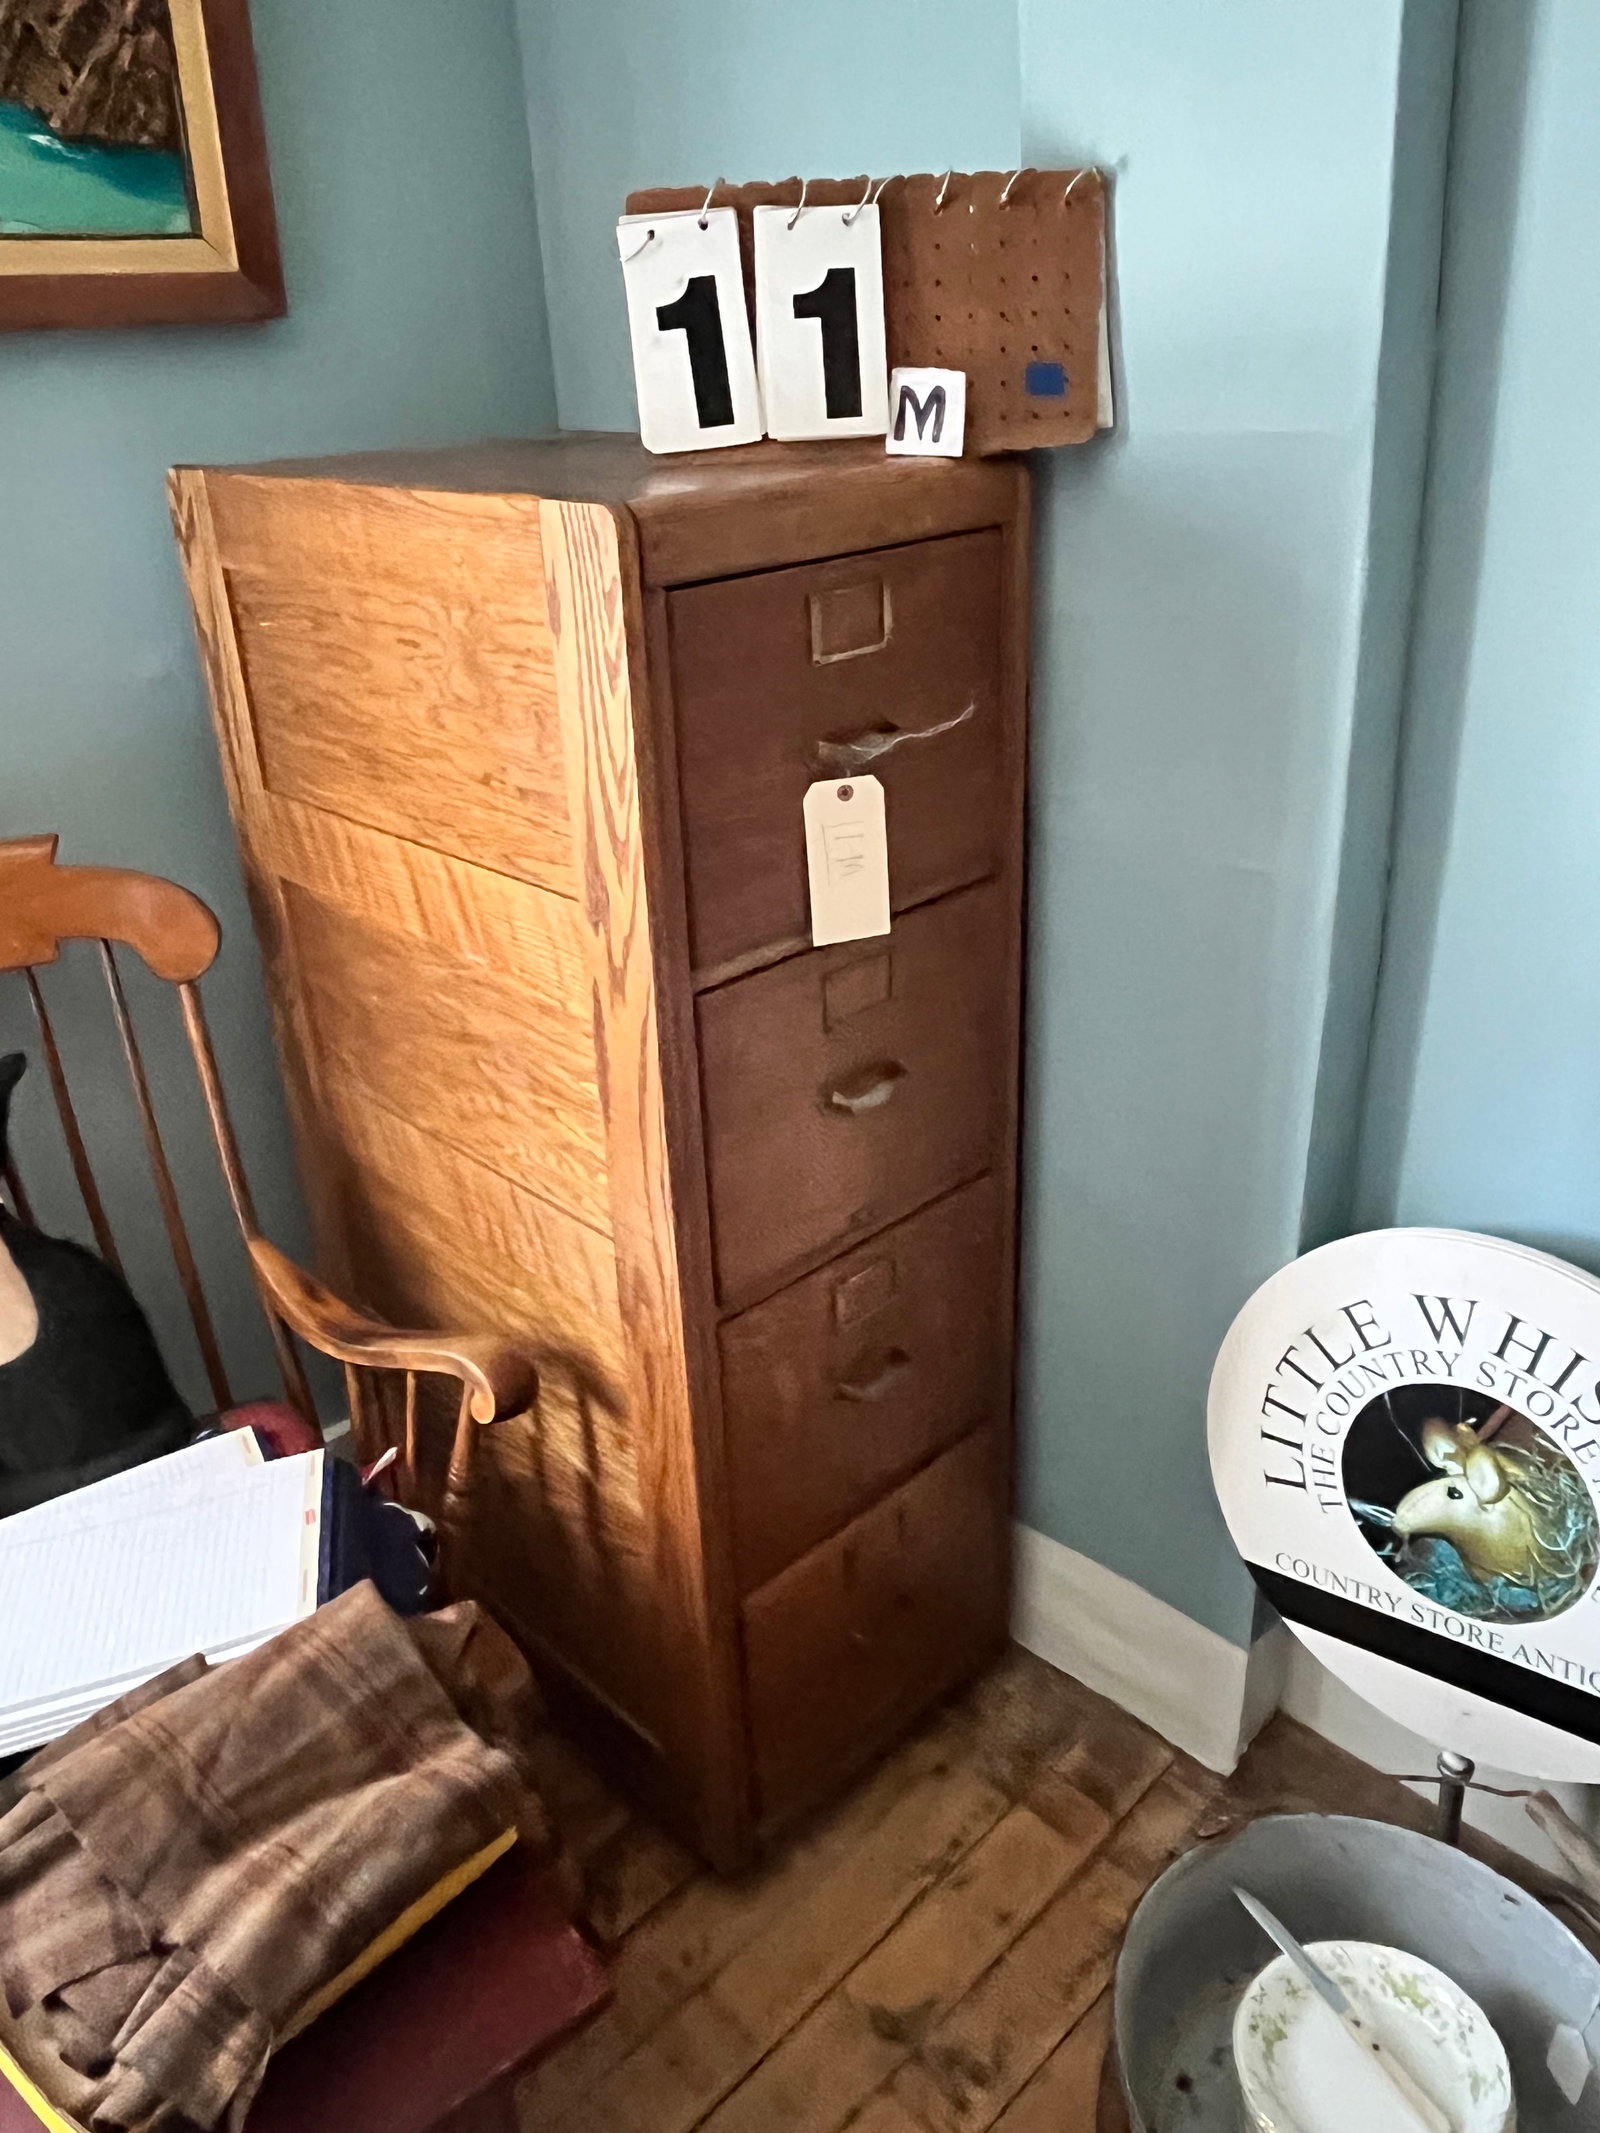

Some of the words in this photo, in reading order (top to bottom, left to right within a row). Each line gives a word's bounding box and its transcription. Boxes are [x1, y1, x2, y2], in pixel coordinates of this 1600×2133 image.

[893, 385, 946, 443] M
[1260, 1299, 1392, 1493] LITTLE
[1316, 1350, 1462, 1435] COUNTRY
[1476, 1361, 1597, 1464] STORE
[1311, 1443, 1343, 1514] THE
[1275, 1552, 1402, 1613] COUNTRY
[1410, 1603, 1505, 1654] STORE
